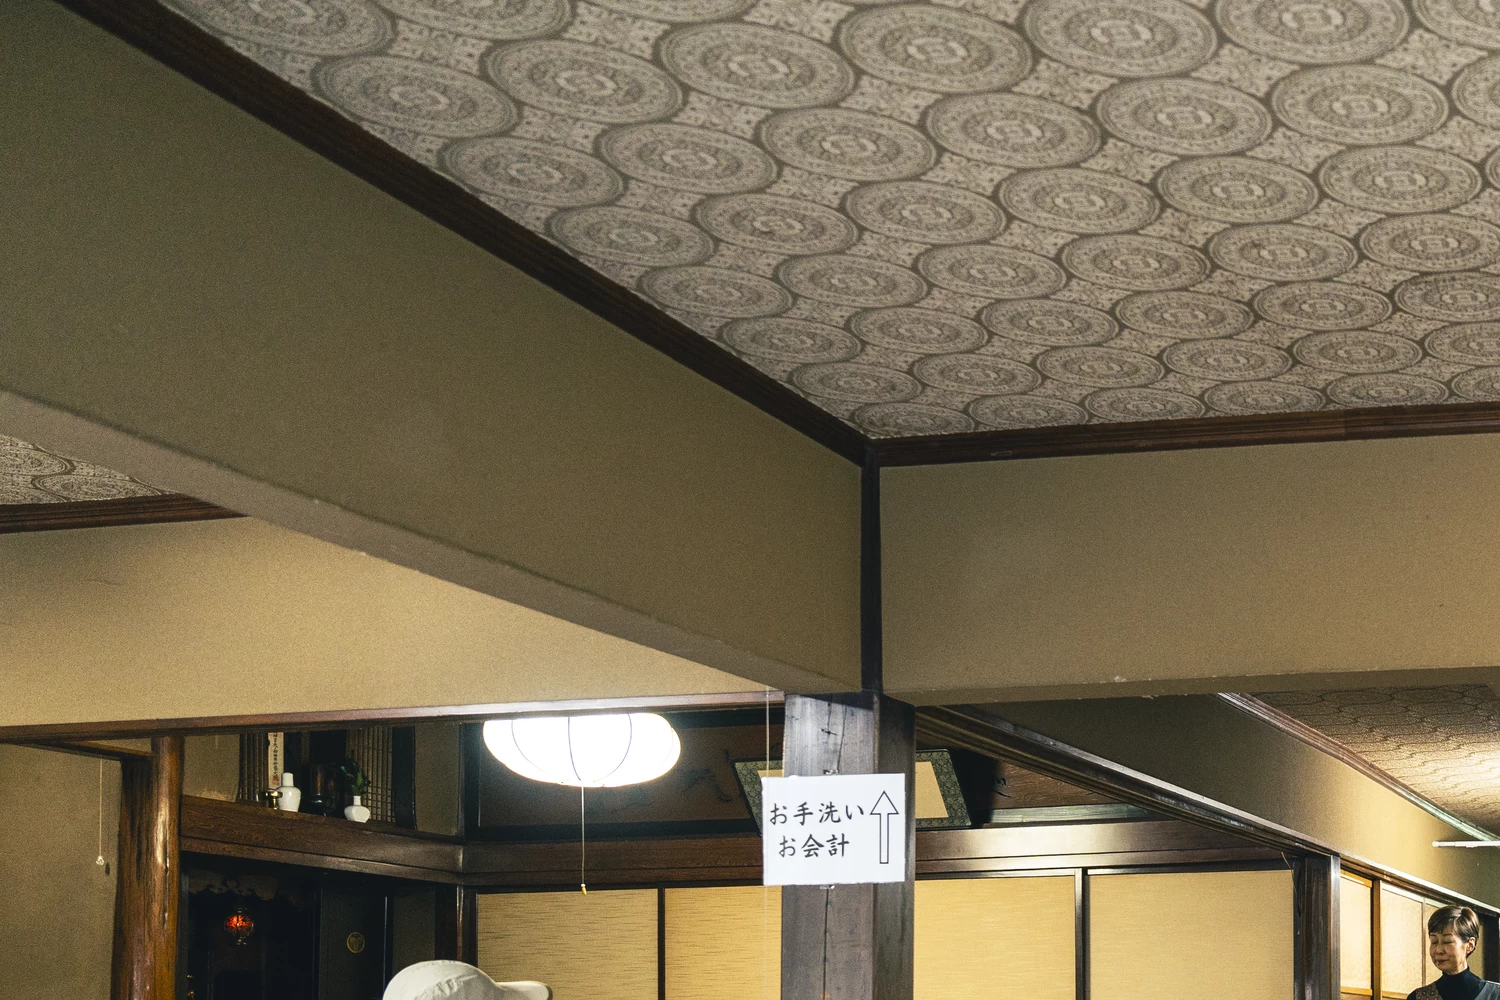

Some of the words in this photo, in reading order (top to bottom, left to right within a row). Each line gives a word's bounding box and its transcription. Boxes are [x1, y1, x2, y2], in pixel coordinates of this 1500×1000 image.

[769, 801, 865, 826] お手洗い
[778, 833, 850, 858] お会計
